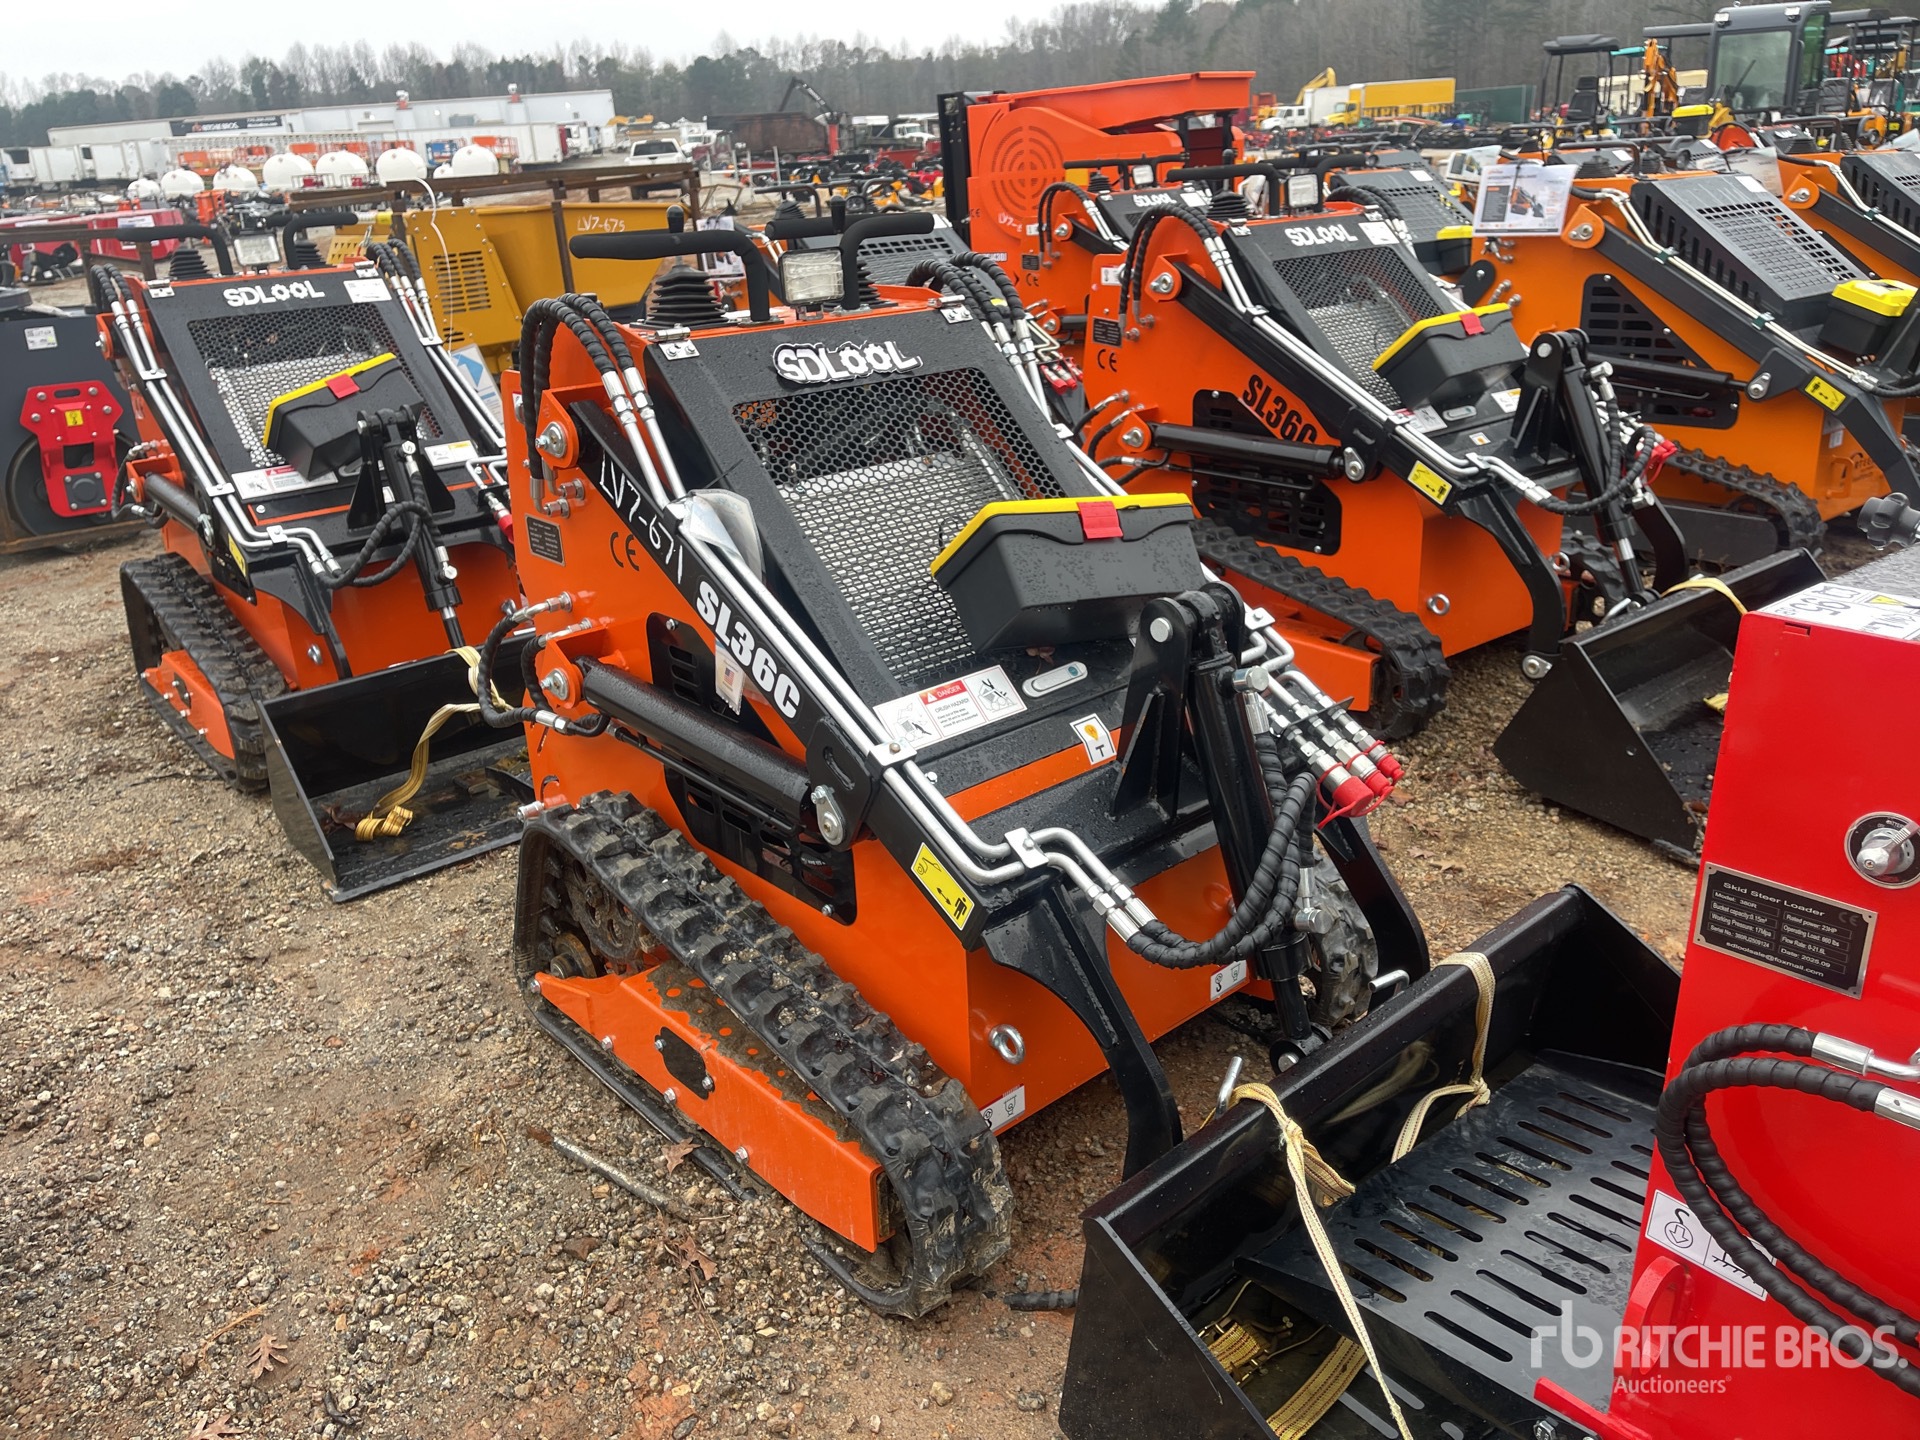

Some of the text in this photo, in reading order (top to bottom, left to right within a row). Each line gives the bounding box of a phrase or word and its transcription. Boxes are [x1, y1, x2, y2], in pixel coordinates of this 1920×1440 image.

[577, 214, 626, 233] LV7-675
[1284, 223, 1359, 247] SDLOOL
[222, 280, 326, 307] SDLOOL
[776, 340, 919, 383] SDLOOL
[599, 450, 684, 584] LV7-671
[696, 580, 800, 720] SL36C
[936, 684, 962, 698] DANGER
[1714, 891, 1737, 902] Model:
[1723, 882, 1826, 917] Skid Steer Loader
[1712, 902, 1730, 913] Bucket
[1711, 913, 1731, 926] Working
[1786, 914, 1803, 924] Rated
[1821, 925, 1838, 933] 23HP
[1781, 936, 1793, 945] Flow
[1783, 924, 1807, 938] Operating
[1725, 941, 1825, 977] sdloolsale@foxmail.com
[1780, 948, 1831, 968] Date: 2025.09
